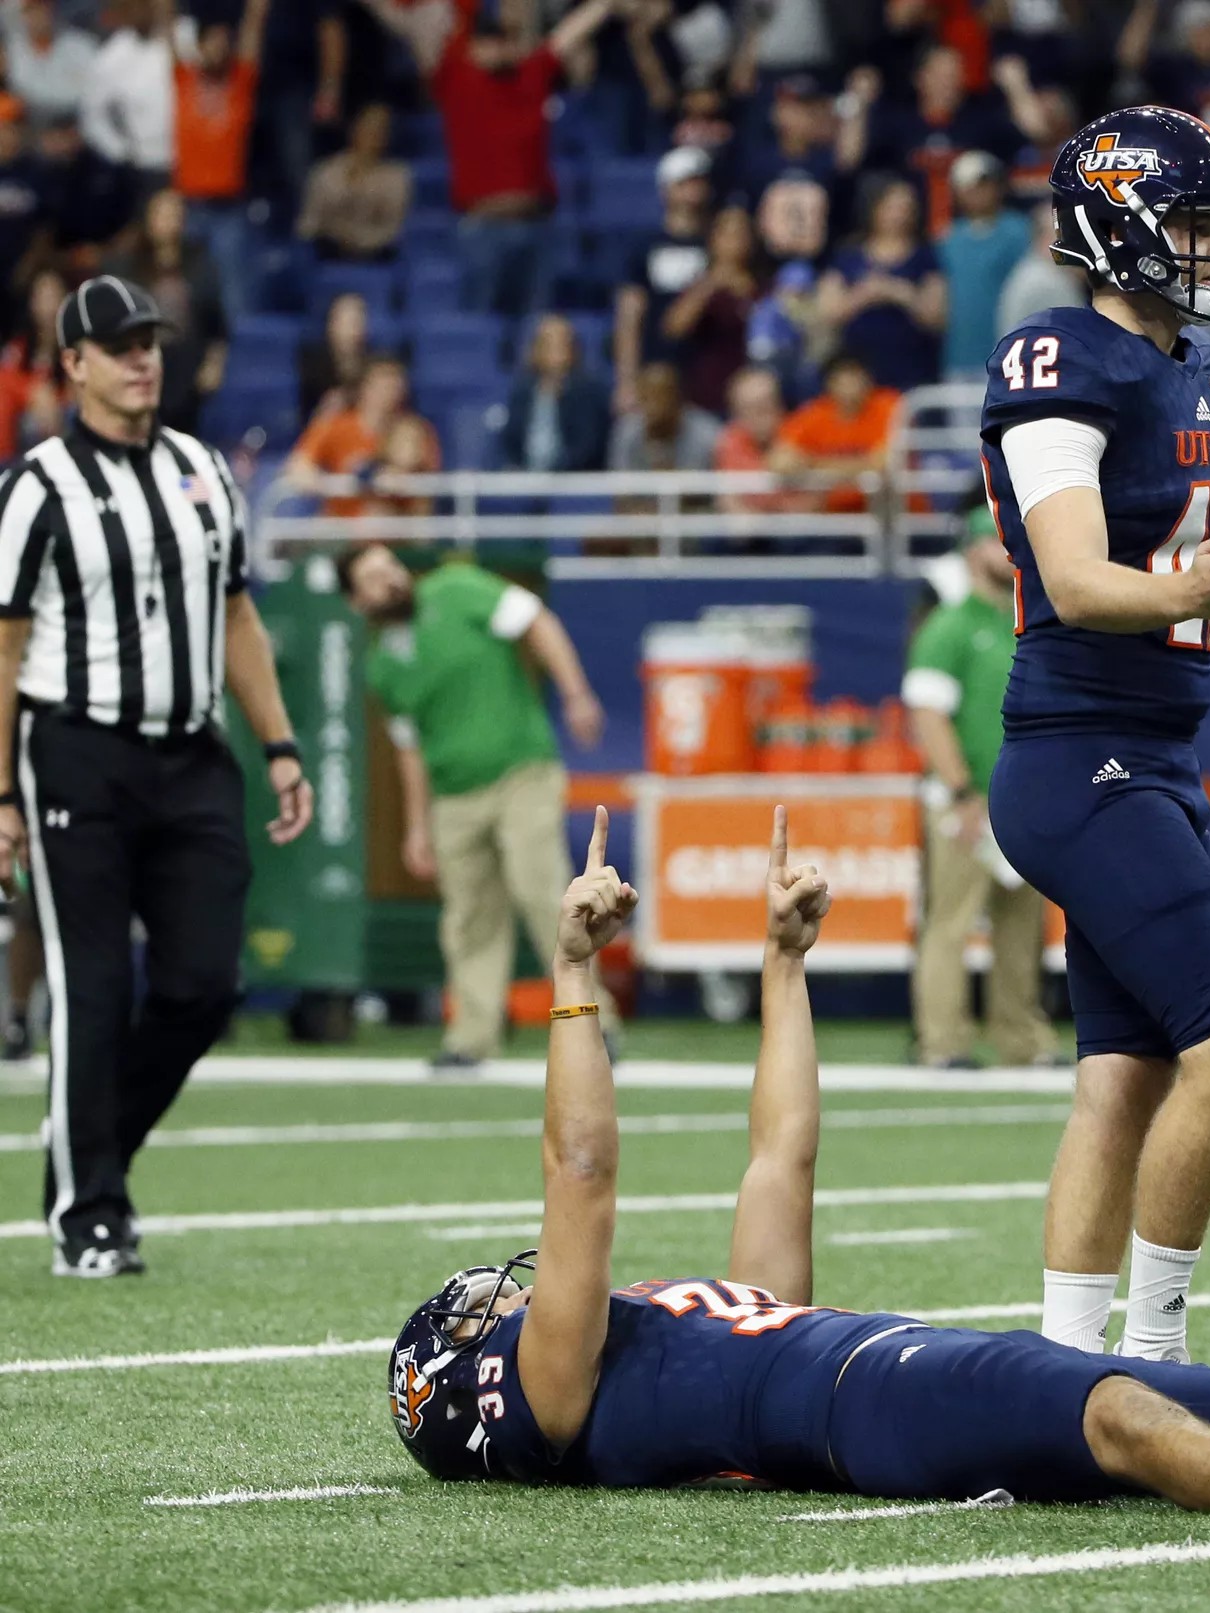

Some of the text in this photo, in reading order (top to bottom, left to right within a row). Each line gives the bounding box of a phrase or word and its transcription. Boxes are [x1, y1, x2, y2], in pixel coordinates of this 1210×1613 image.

[1084, 151, 1156, 171] UTSA
[1002, 336, 1060, 391] 42
[1092, 770, 1131, 784] adidas
[664, 842, 921, 900] GATADE
[395, 1351, 412, 1429] UTSA
[477, 1354, 505, 1423] 39
